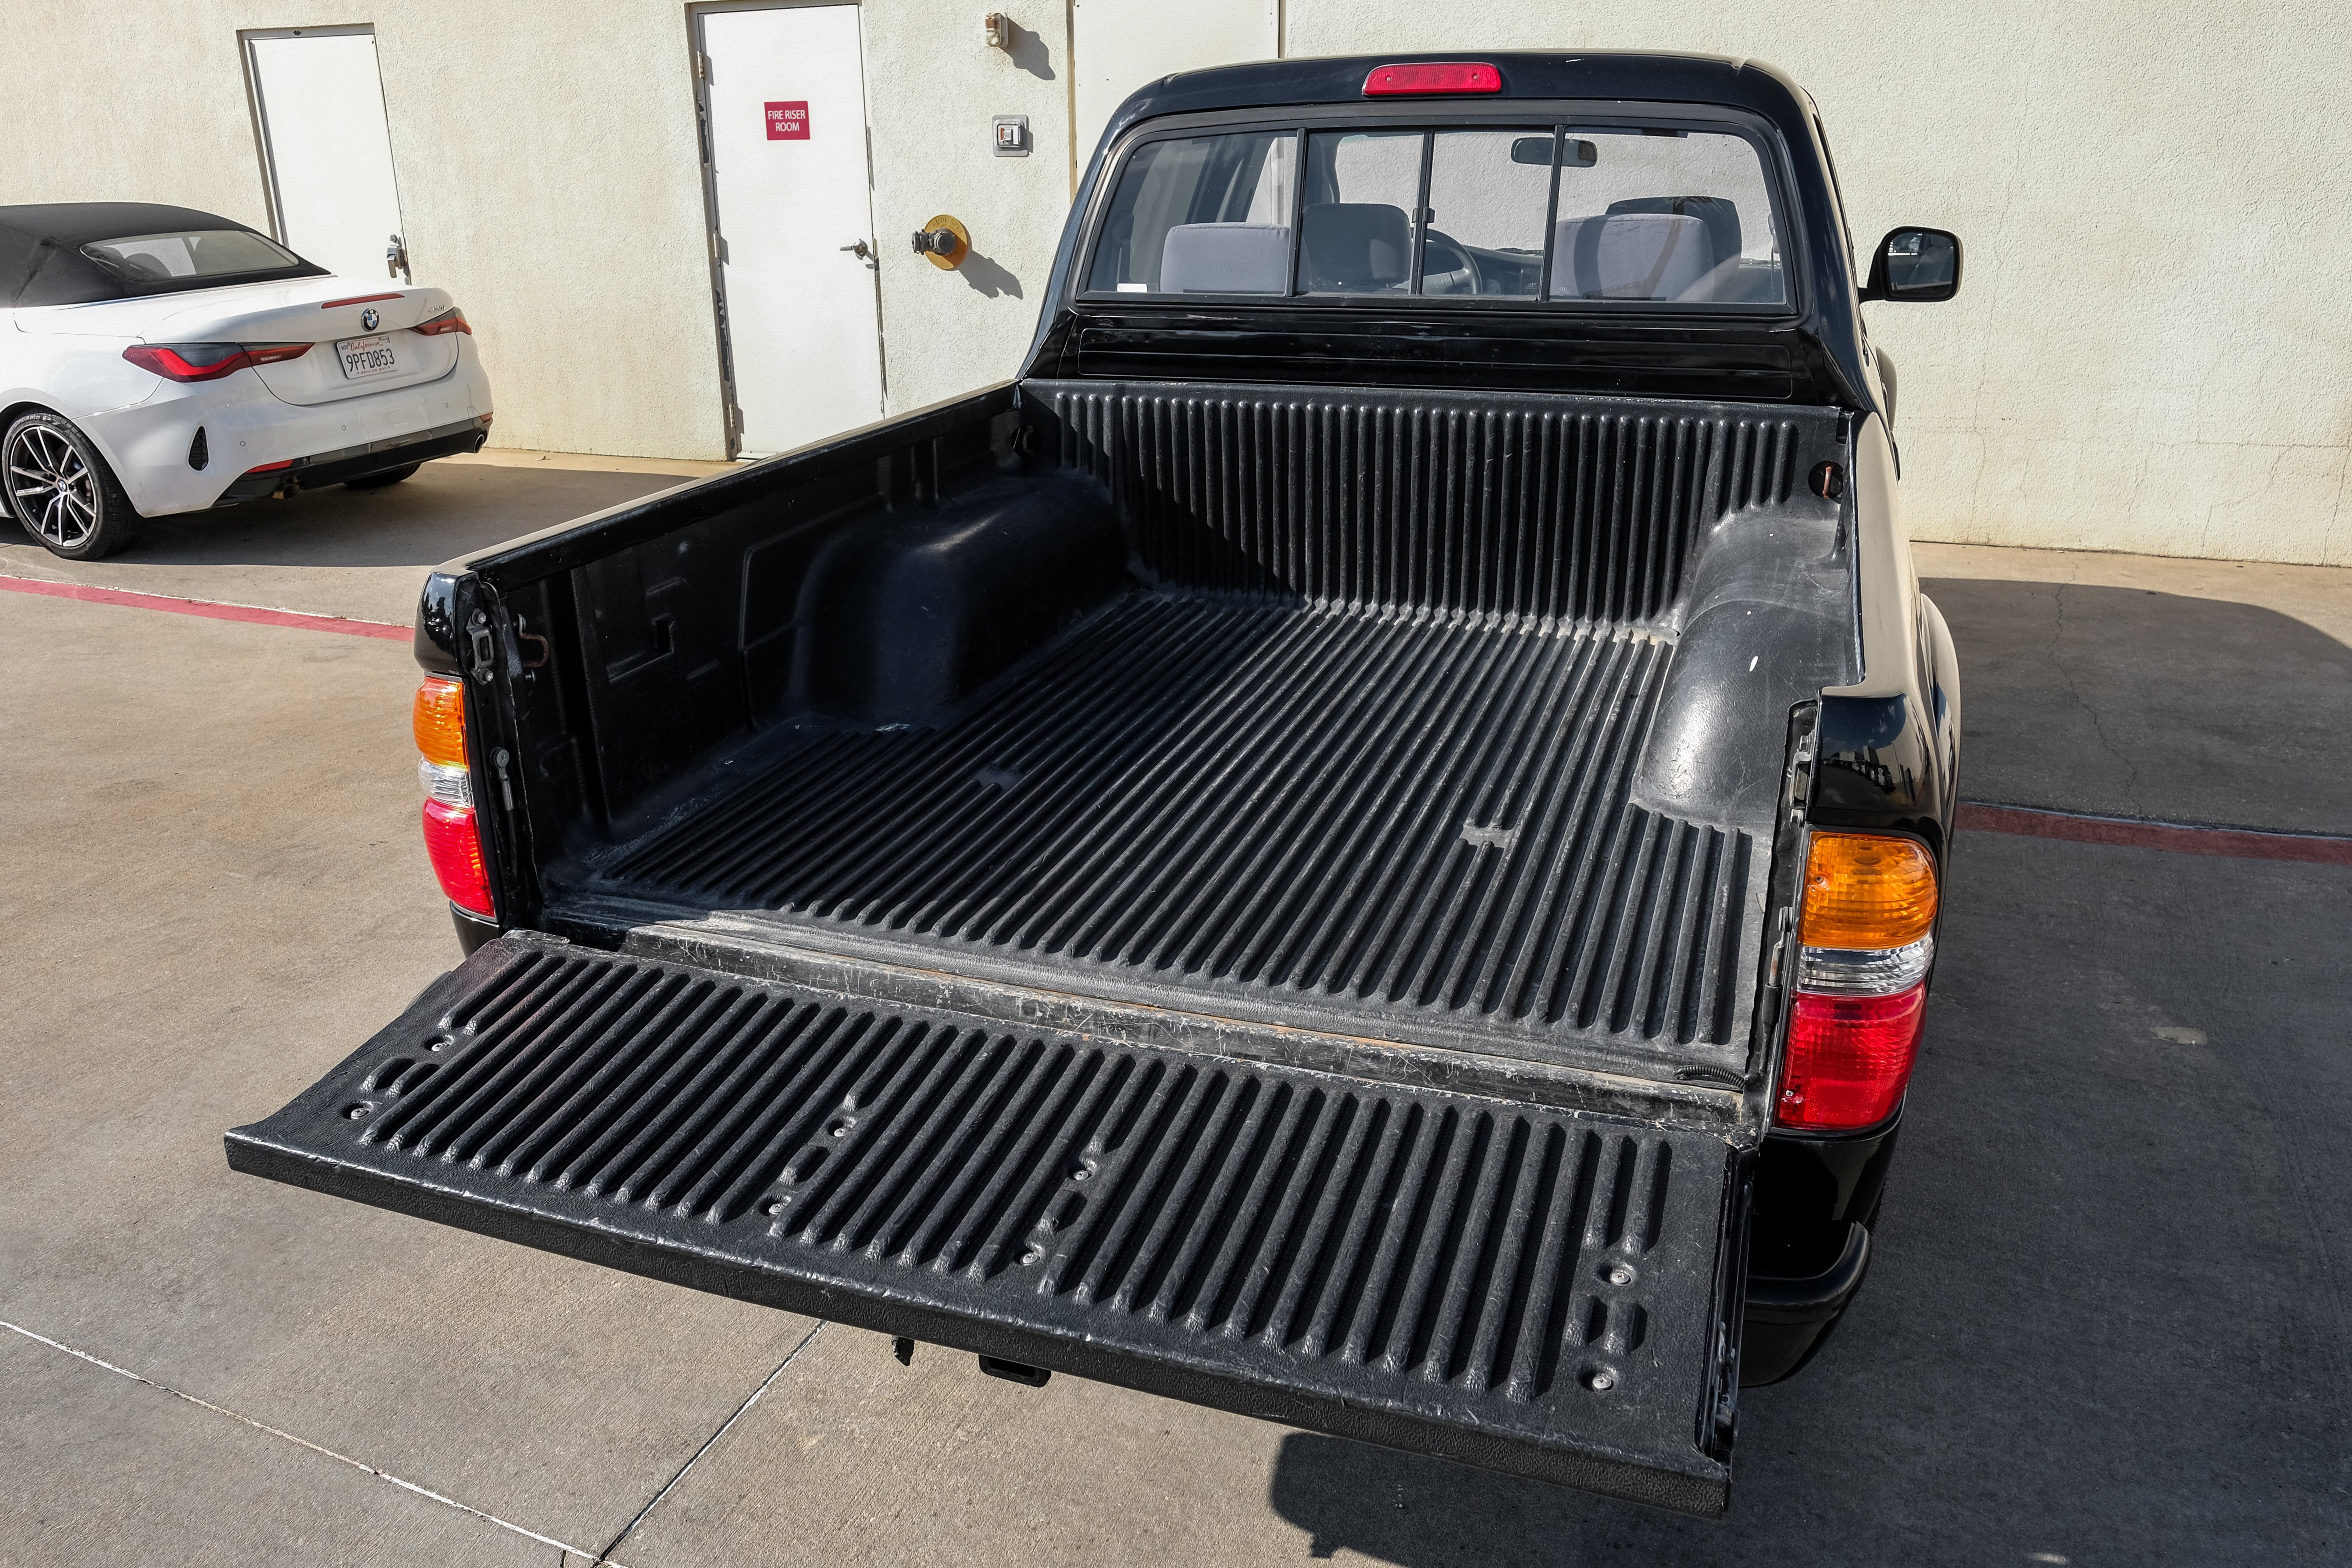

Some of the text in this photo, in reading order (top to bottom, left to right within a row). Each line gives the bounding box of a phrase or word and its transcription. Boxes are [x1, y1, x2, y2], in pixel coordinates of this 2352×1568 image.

[768, 110, 806, 120] FIRE RISER
[775, 122, 799, 132] ROOM
[350, 341, 383, 352] California
[346, 348, 395, 372] 9PFD853
